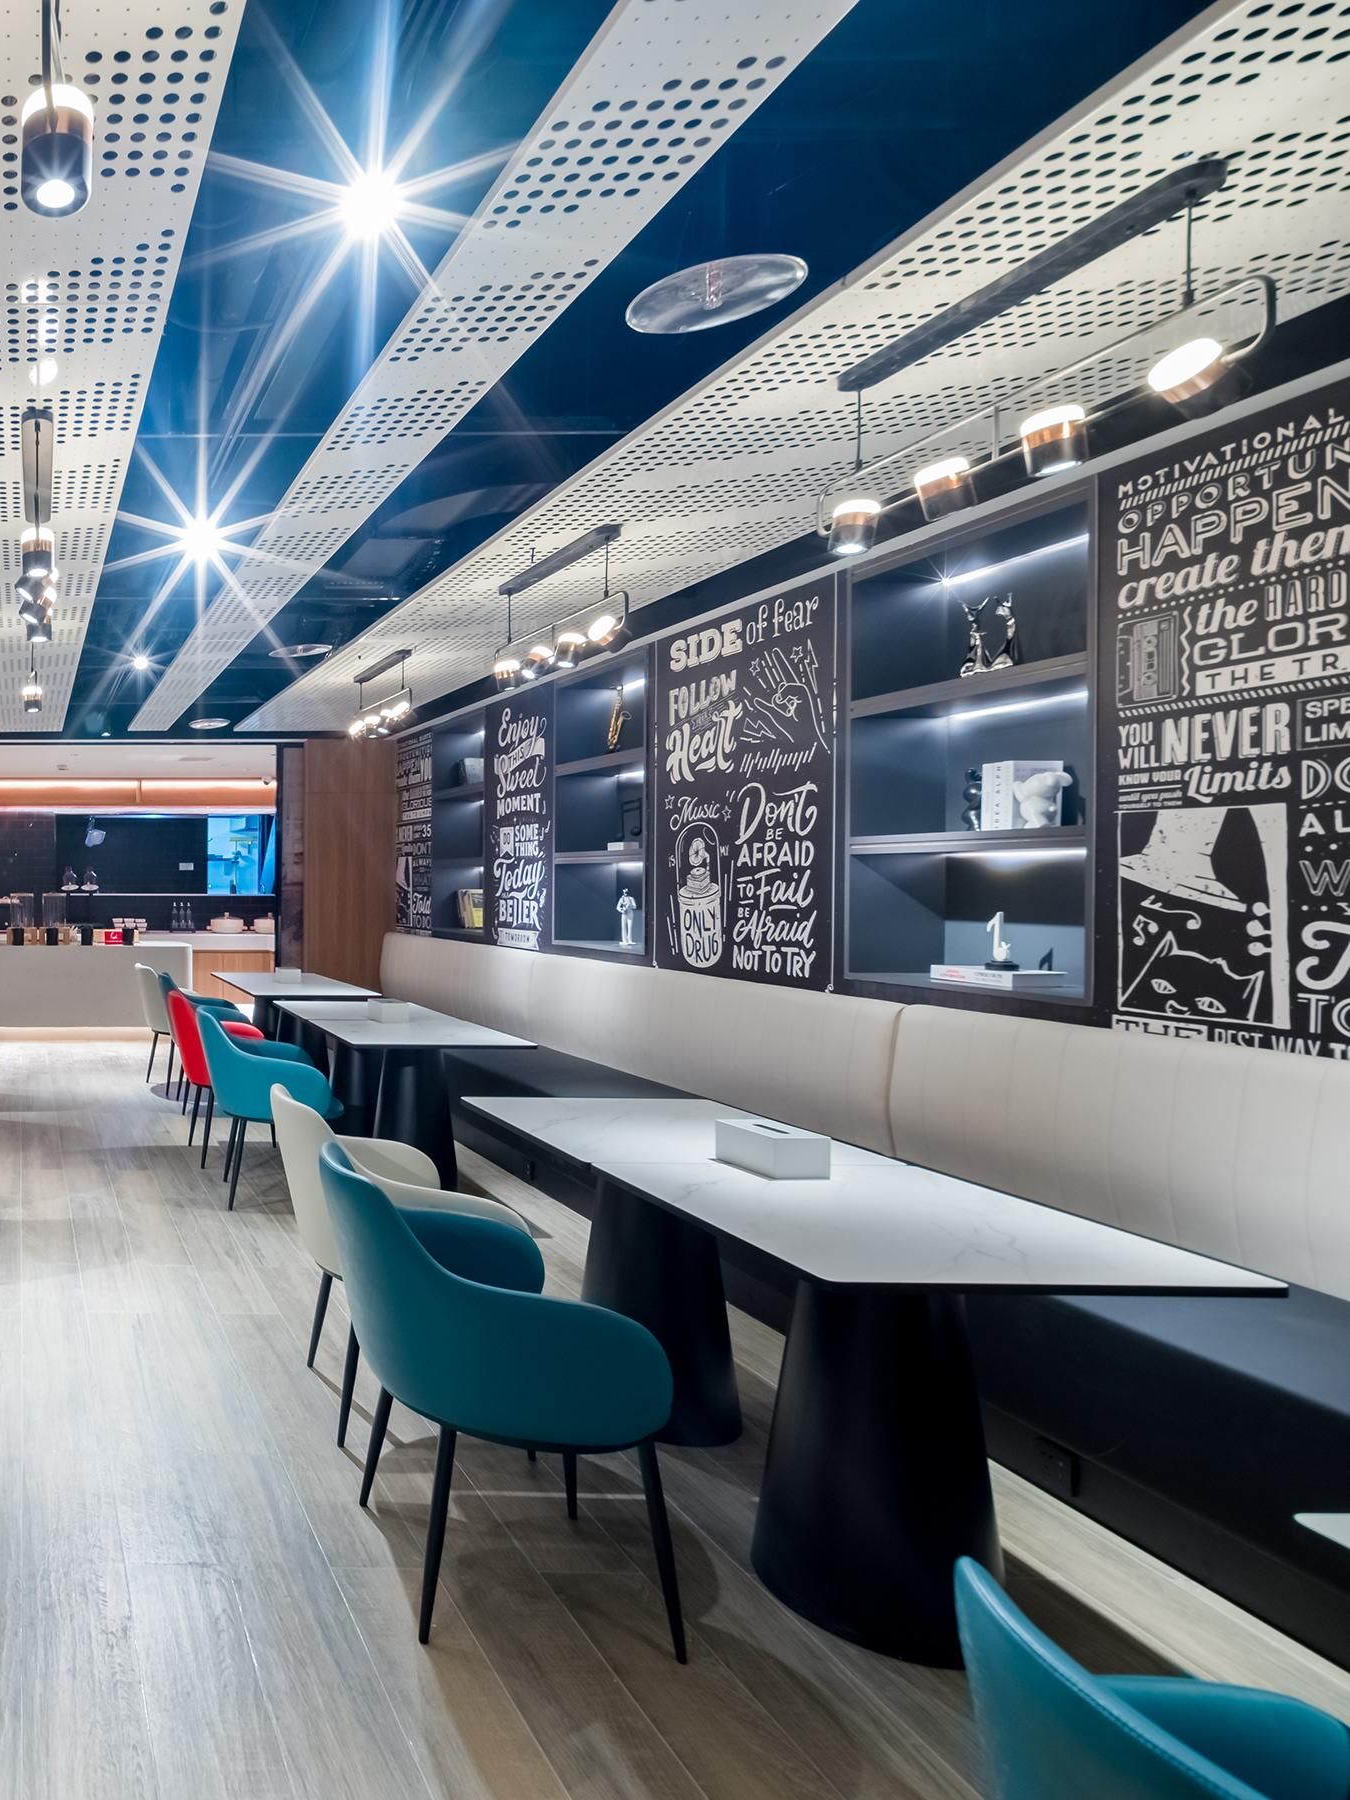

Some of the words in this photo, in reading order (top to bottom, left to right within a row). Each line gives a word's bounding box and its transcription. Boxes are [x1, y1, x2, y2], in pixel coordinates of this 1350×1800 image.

[1117, 408, 1345, 498] MOTIVATIONAL
[1118, 552, 1242, 609] create
[1195, 597, 1259, 635] the
[1264, 569, 1348, 622] HARD
[669, 618, 743, 672] SIDE
[746, 604, 769, 645] of
[772, 596, 819, 638] fear
[1193, 612, 1349, 666] GLOR
[1205, 663, 1275, 690] THE
[1292, 652, 1348, 678] TR
[669, 669, 738, 727] FOLLOW
[498, 708, 547, 757] Enjoy
[666, 699, 743, 785] Heart
[1118, 721, 1153, 747] YOU
[1161, 702, 1291, 766] NEVER
[509, 746, 525, 766] THIS
[1118, 745, 1160, 769] WILL
[497, 754, 547, 798] Sweet
[1118, 772, 1150, 786] KNOW
[1152, 769, 1182, 783] YOUR
[1184, 761, 1292, 803] Limits
[496, 793, 541, 819] MOMENT
[670, 796, 720, 831] Music
[421, 824, 432, 838] 35
[514, 823, 539, 842] SOME
[515, 841, 539, 857] THING
[765, 827, 784, 841] BE
[736, 840, 815, 867] AFRAID
[493, 857, 545, 900] Today
[737, 883, 754, 899] TO
[754, 868, 814, 911] Fail
[498, 886, 542, 931] BETTER
[683, 908, 716, 932] ONLY
[737, 907, 750, 918] BE
[685, 932, 719, 963] DRUG
[732, 909, 817, 950] Afraid
[732, 944, 762, 971] NOT
[761, 945, 782, 973] TO
[781, 946, 816, 978] TRY
